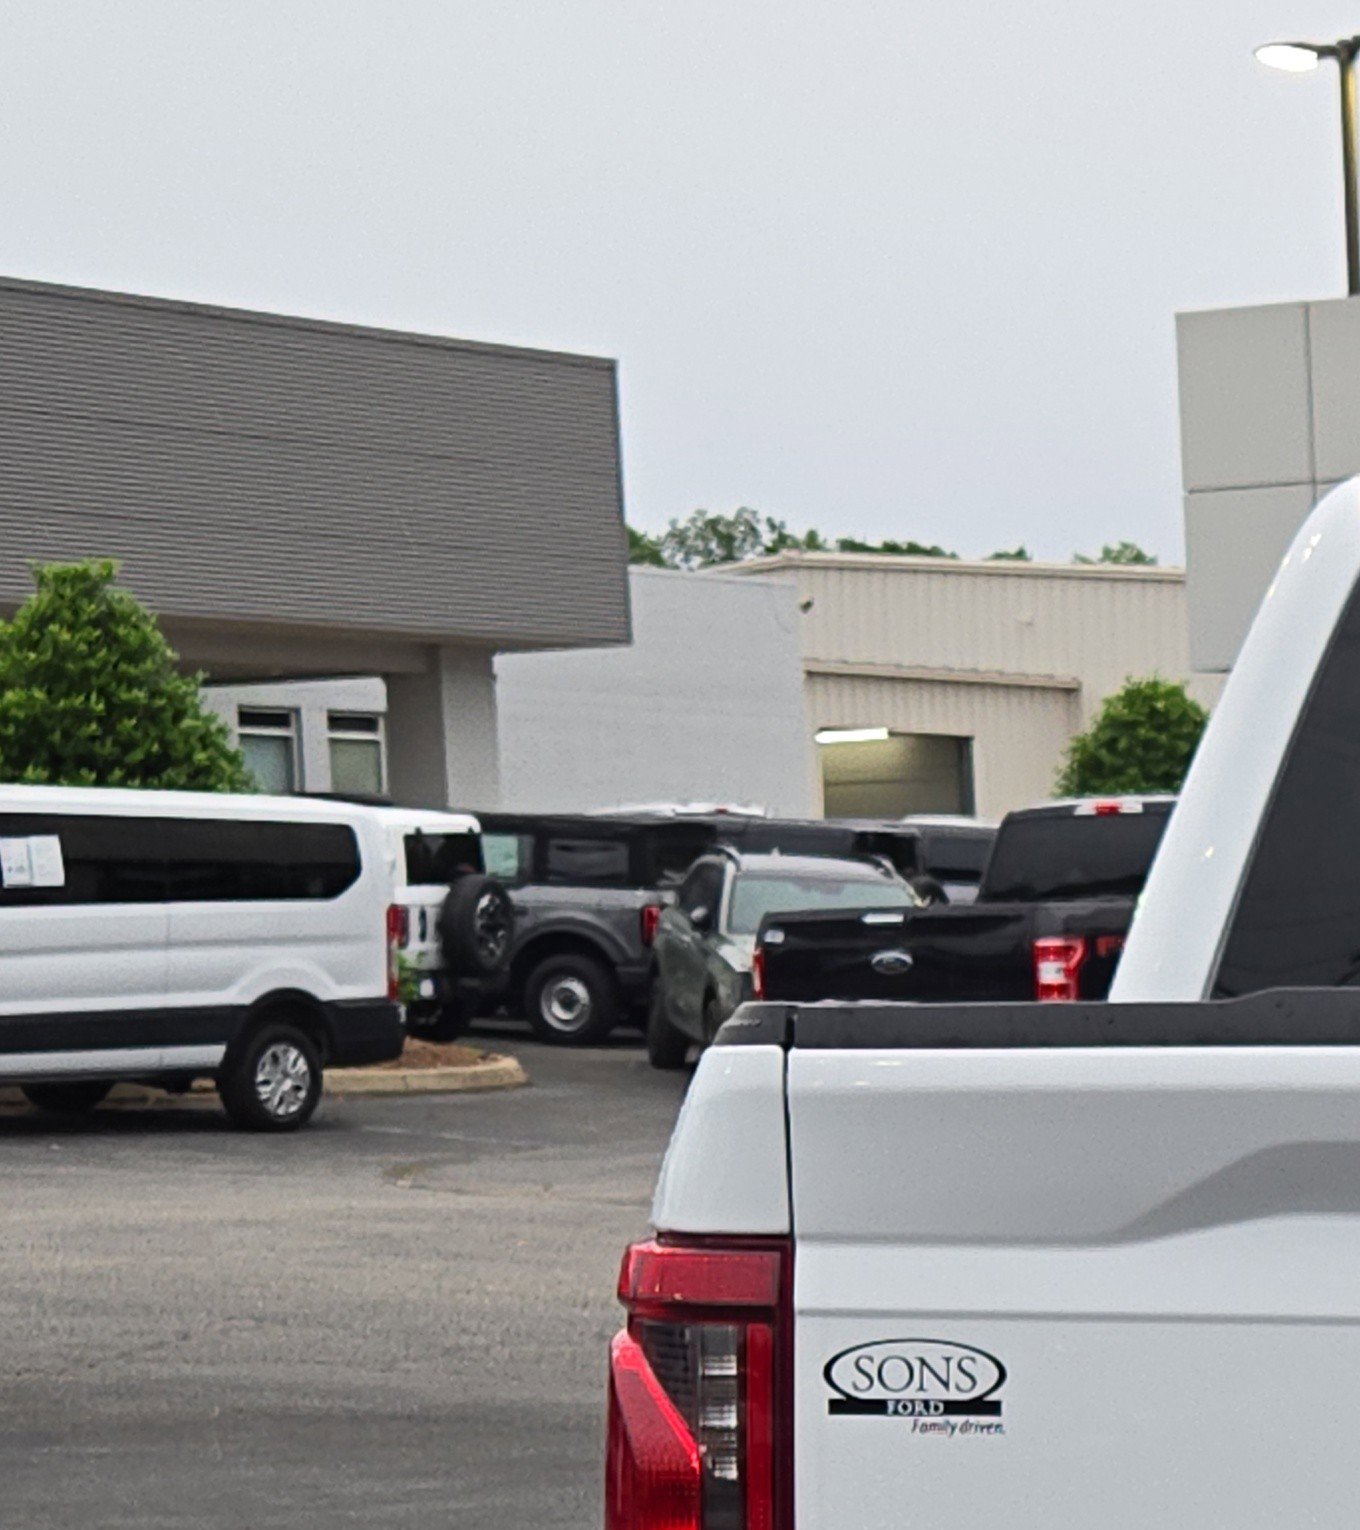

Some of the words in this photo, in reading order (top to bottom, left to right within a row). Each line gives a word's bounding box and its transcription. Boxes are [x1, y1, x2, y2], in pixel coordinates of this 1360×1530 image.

[852, 1354, 978, 1393] SONS
[886, 1400, 945, 1416] FORD
[911, 1418, 957, 1437] Family
